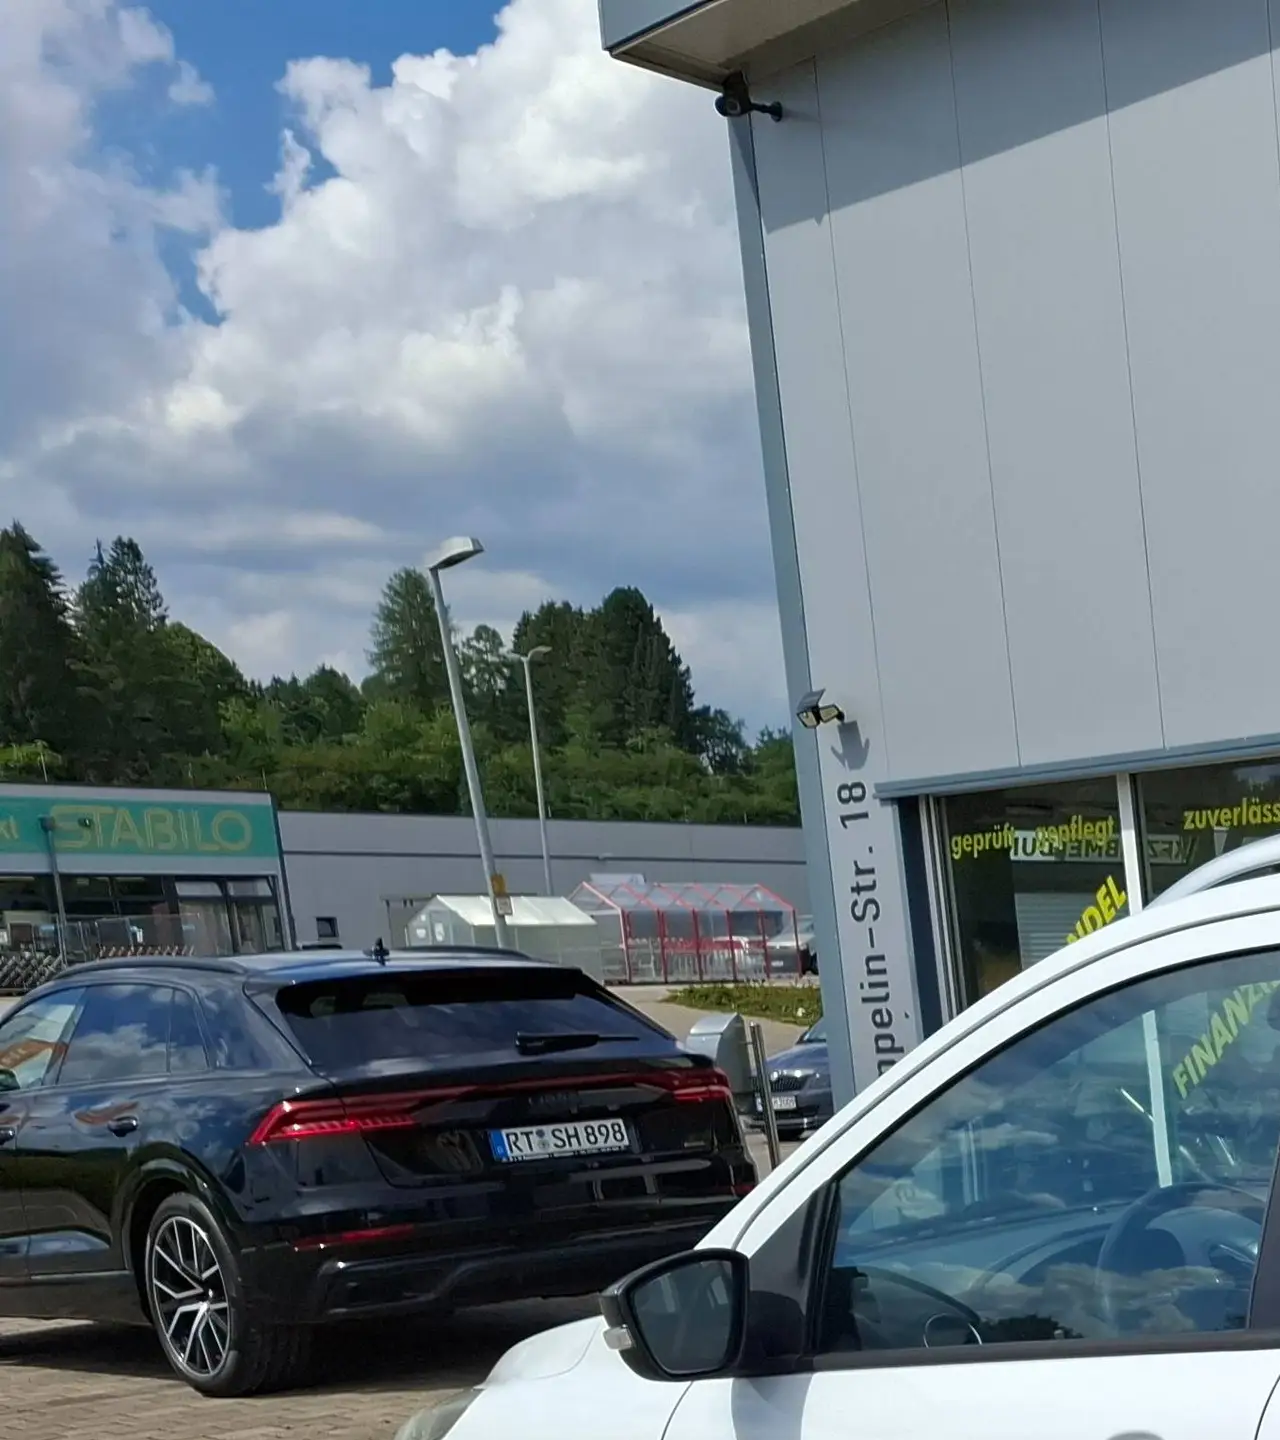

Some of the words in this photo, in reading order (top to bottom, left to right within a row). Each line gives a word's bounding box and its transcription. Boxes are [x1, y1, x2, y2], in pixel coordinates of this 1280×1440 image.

[51, 804, 253, 850] STABILO
[836, 781, 869, 829] 18
[506, 1130, 534, 1153] RT
[551, 1126, 581, 1148] SH
[584, 1122, 625, 1145] 898
